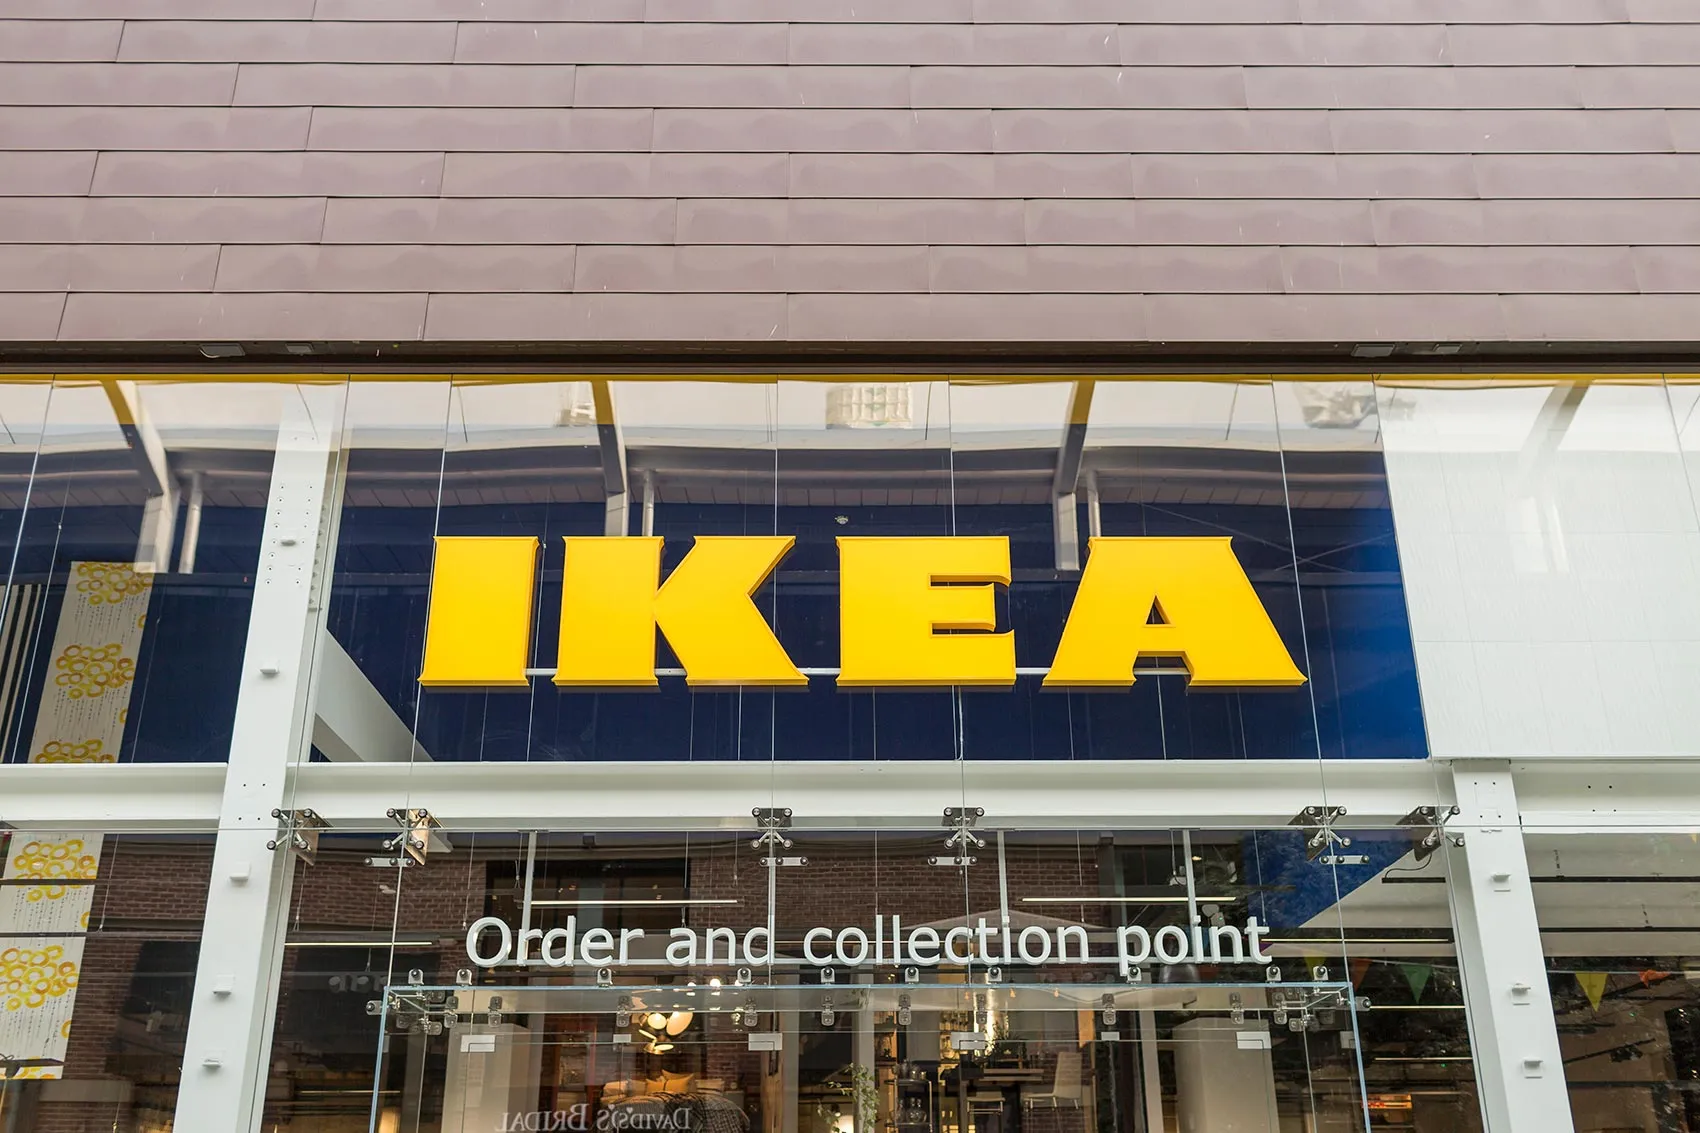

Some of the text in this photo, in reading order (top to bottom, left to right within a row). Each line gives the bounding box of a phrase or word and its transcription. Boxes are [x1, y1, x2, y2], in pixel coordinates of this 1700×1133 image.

[418, 535, 1307, 688] IKEA
[465, 914, 1273, 976] Order and collection point
